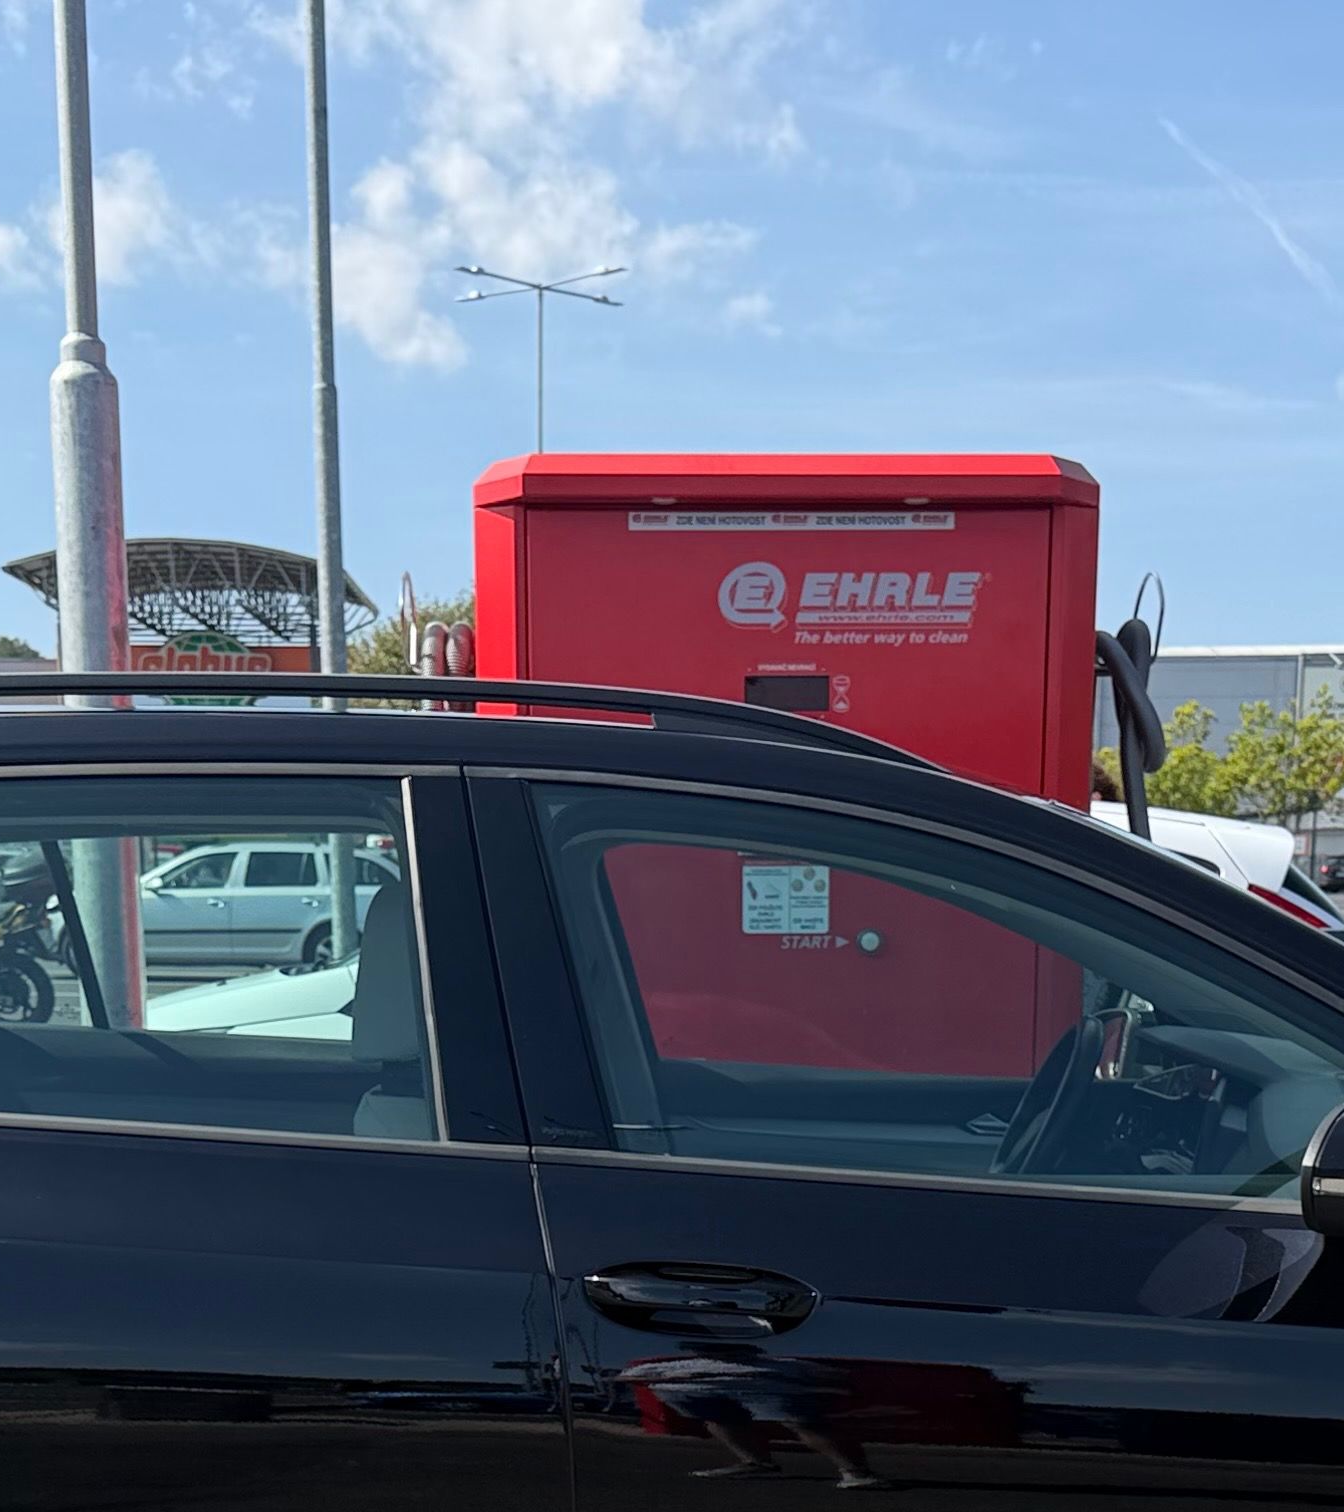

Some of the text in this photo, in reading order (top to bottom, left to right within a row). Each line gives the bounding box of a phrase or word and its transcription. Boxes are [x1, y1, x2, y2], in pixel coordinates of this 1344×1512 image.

[799, 572, 982, 608] EHRLE
[817, 612, 955, 623] www.ehrle.com
[794, 631, 968, 646] The better way to clean
[780, 936, 831, 950] START
